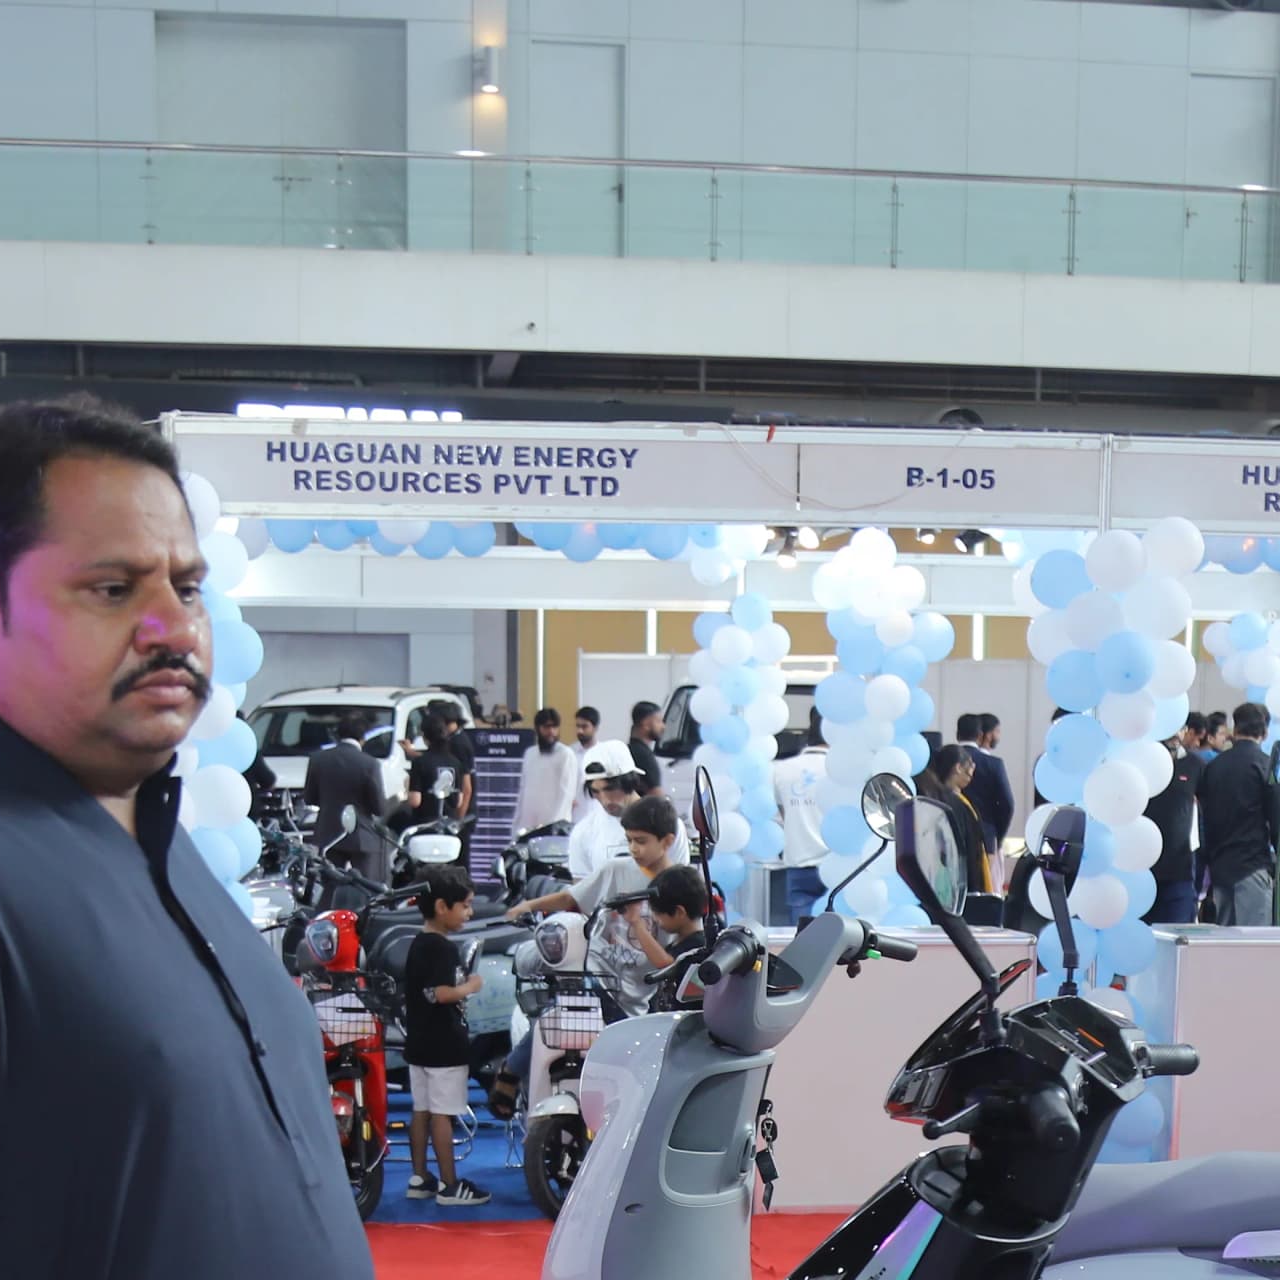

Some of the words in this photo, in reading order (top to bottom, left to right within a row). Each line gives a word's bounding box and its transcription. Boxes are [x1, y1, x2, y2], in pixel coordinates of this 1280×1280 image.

[266, 441, 422, 466] HUAGUAN
[433, 444, 503, 467] NEW
[513, 446, 640, 470] ENERGY
[293, 469, 482, 495] RESOURCES
[493, 473, 553, 497] PVT
[564, 475, 620, 498] LTD
[906, 467, 996, 490] B-1-05
